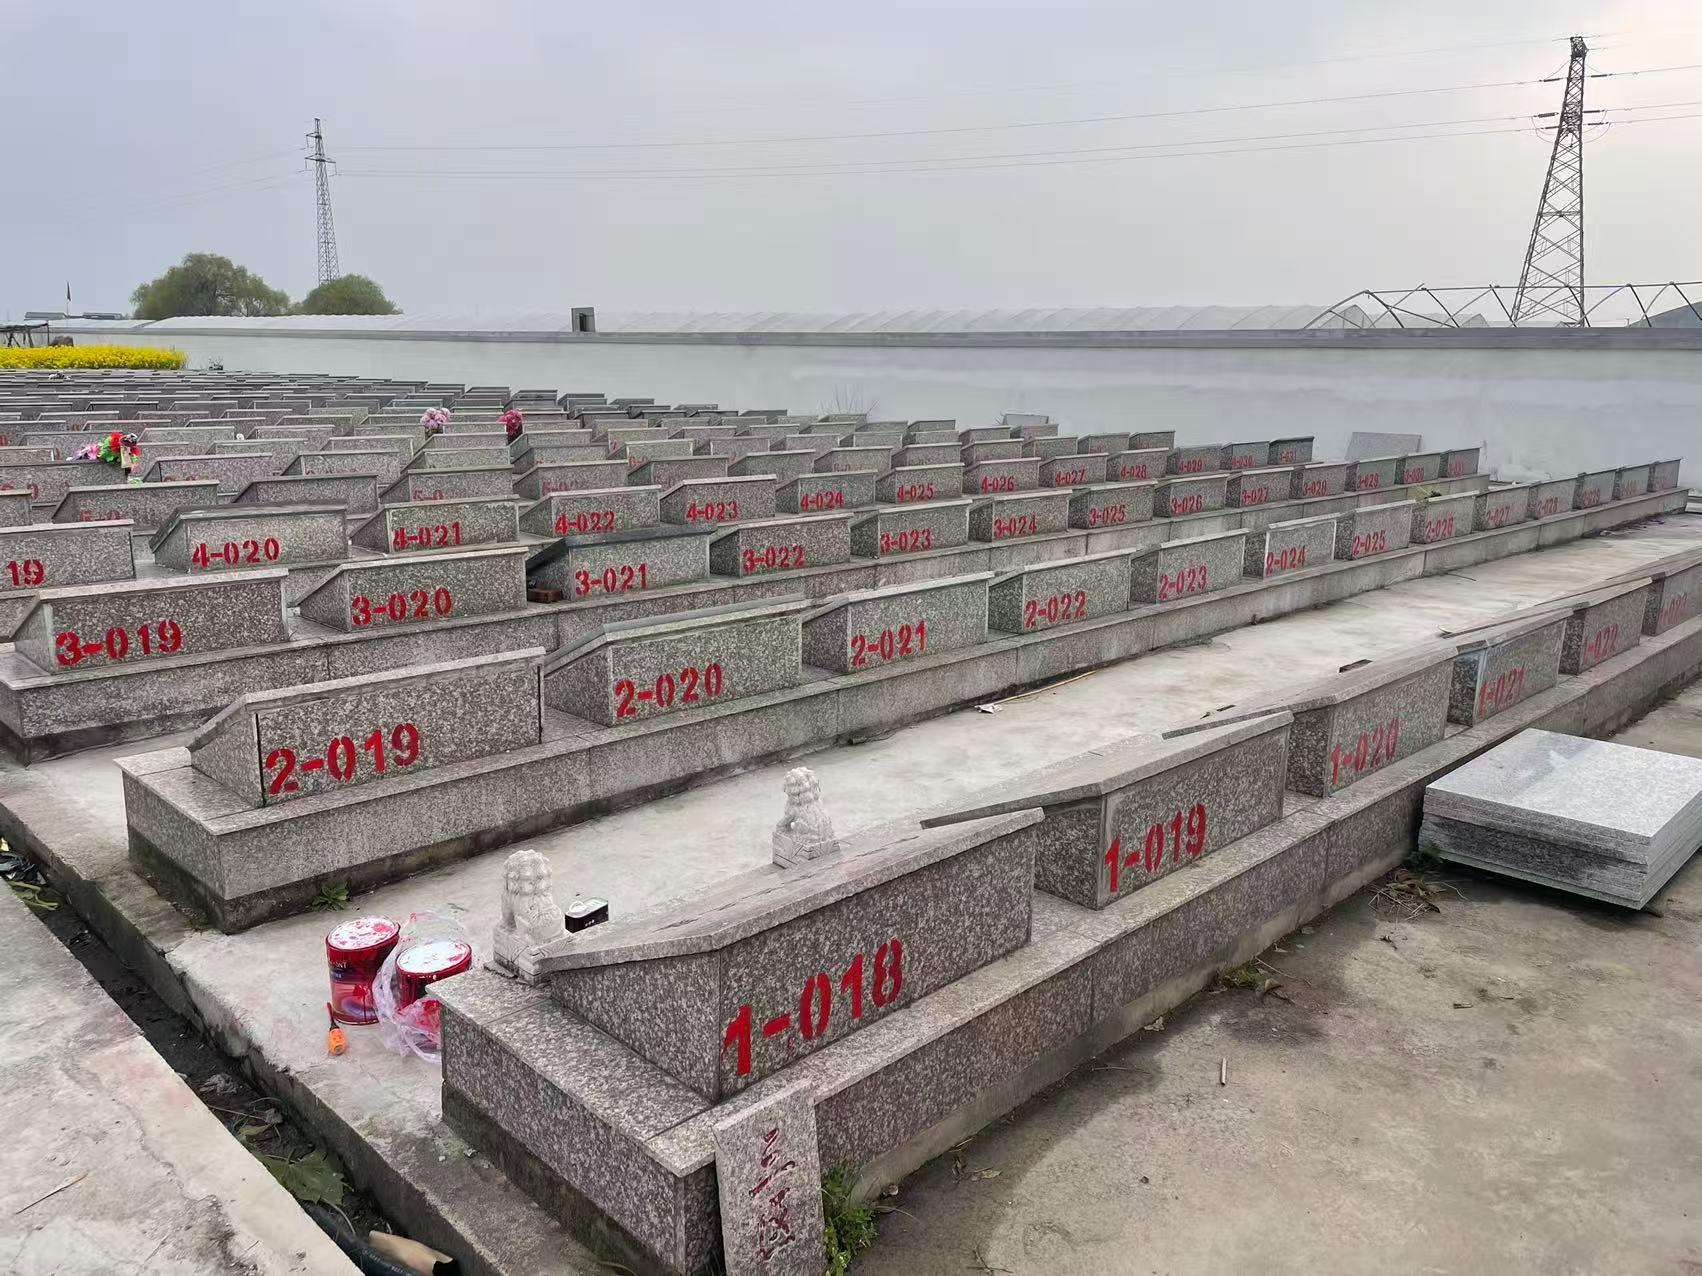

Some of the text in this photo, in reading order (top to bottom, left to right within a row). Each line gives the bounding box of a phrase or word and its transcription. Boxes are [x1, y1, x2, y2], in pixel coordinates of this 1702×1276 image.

[981, 476, 1016, 495] 4-026
[1055, 465, 1086, 487] 4-027
[801, 491, 844, 511] 4-024
[897, 483, 935, 503] 4-025
[1171, 496, 1202, 516] 3-026
[1241, 488, 1268, 504] 3-027
[554, 511, 615, 535] 4-022
[687, 502, 738, 522] 4-023
[994, 513, 1037, 539] 3-024
[1088, 504, 1126, 527] 3-025
[392, 522, 461, 549] 4-021
[881, 528, 932, 553] 3-023
[1352, 529, 1388, 558] 2-025
[192, 538, 280, 568] 4-020
[742, 545, 805, 573] 3-022
[1265, 548, 1306, 576] 2-024
[575, 562, 647, 596] 3-021
[1159, 565, 1207, 601] 2-023
[352, 588, 452, 626] 3-020
[1024, 592, 1087, 628] 2-022
[56, 620, 182, 666] 3-019
[850, 621, 926, 666] 2-021
[614, 663, 723, 719] 2-020
[1477, 668, 1527, 719] 1-021
[265, 723, 421, 796] 2-019
[1331, 719, 1400, 785] 1-020
[1104, 804, 1207, 894] 1-019
[723, 939, 904, 1076] 1-018
